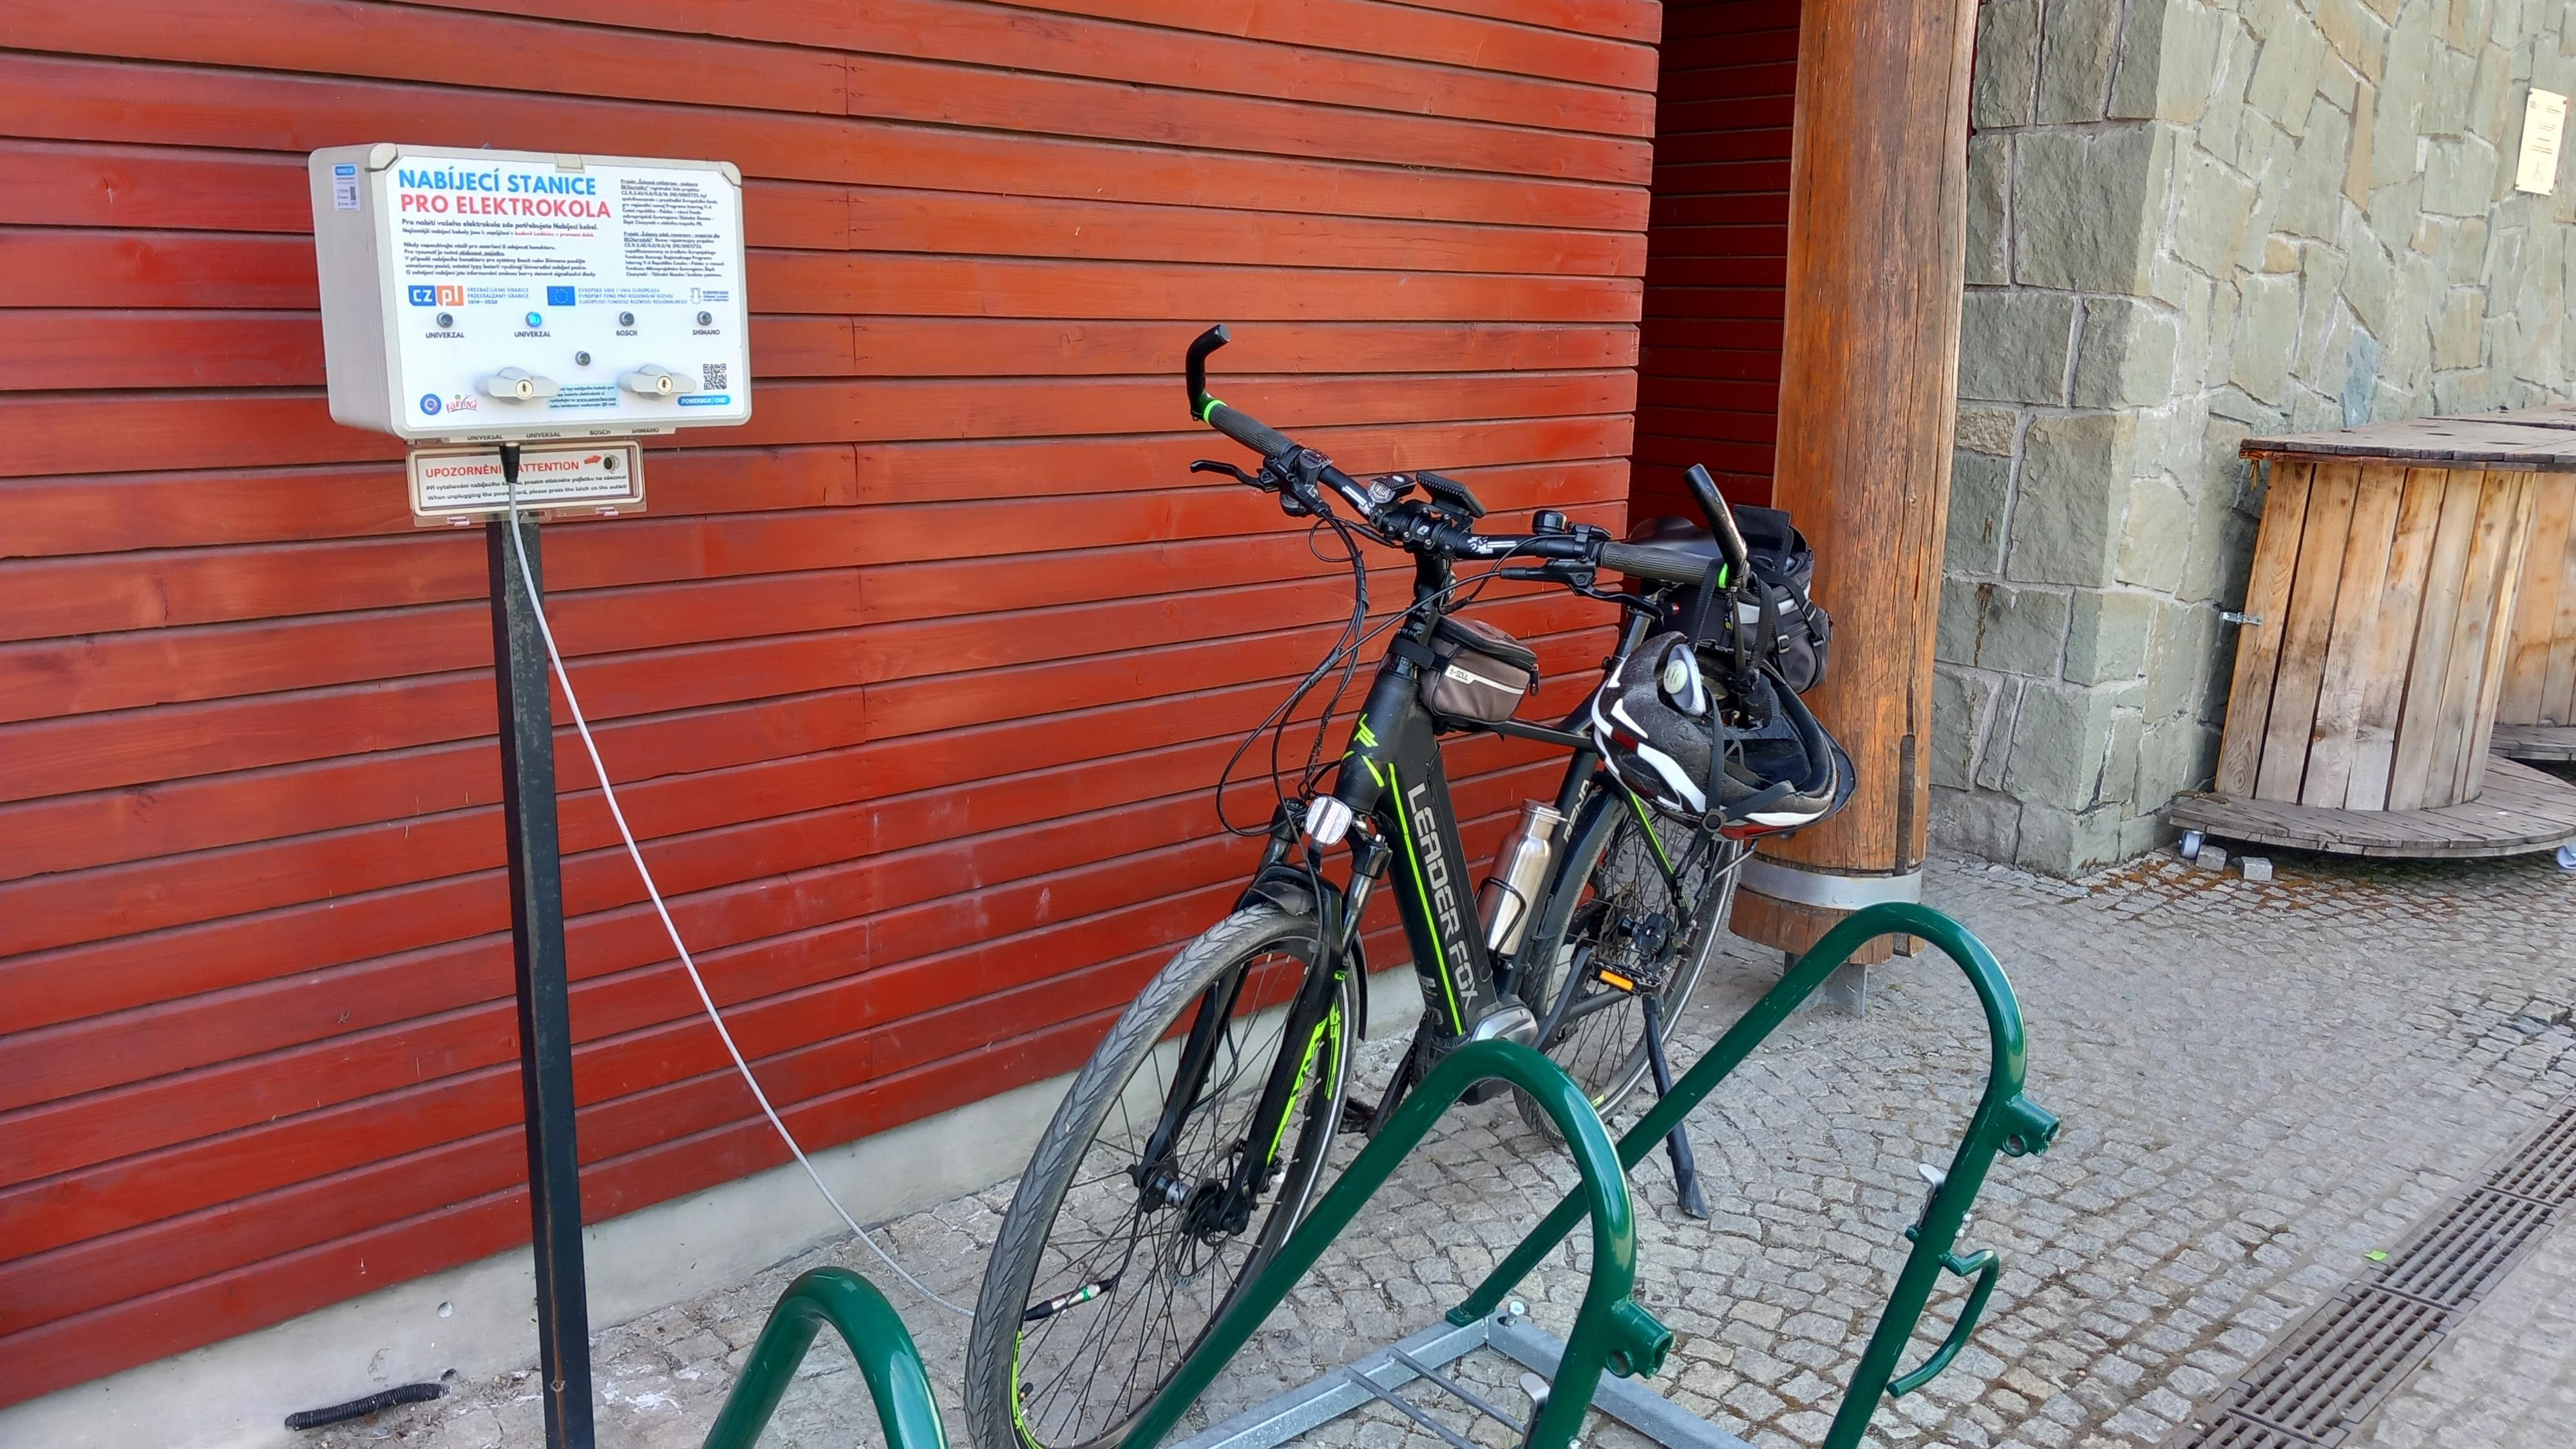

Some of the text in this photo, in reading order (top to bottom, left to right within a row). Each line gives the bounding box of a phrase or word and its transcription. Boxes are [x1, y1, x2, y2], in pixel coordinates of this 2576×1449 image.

[399, 166, 500, 191] NABÍJECÍ
[507, 175, 596, 195] STANICE
[401, 194, 448, 213] PRO
[456, 196, 611, 218] ELEKTROKOLA
[426, 463, 502, 478] UPOZORNĚNÍ
[1407, 782, 1478, 1010] LEADER FOX
